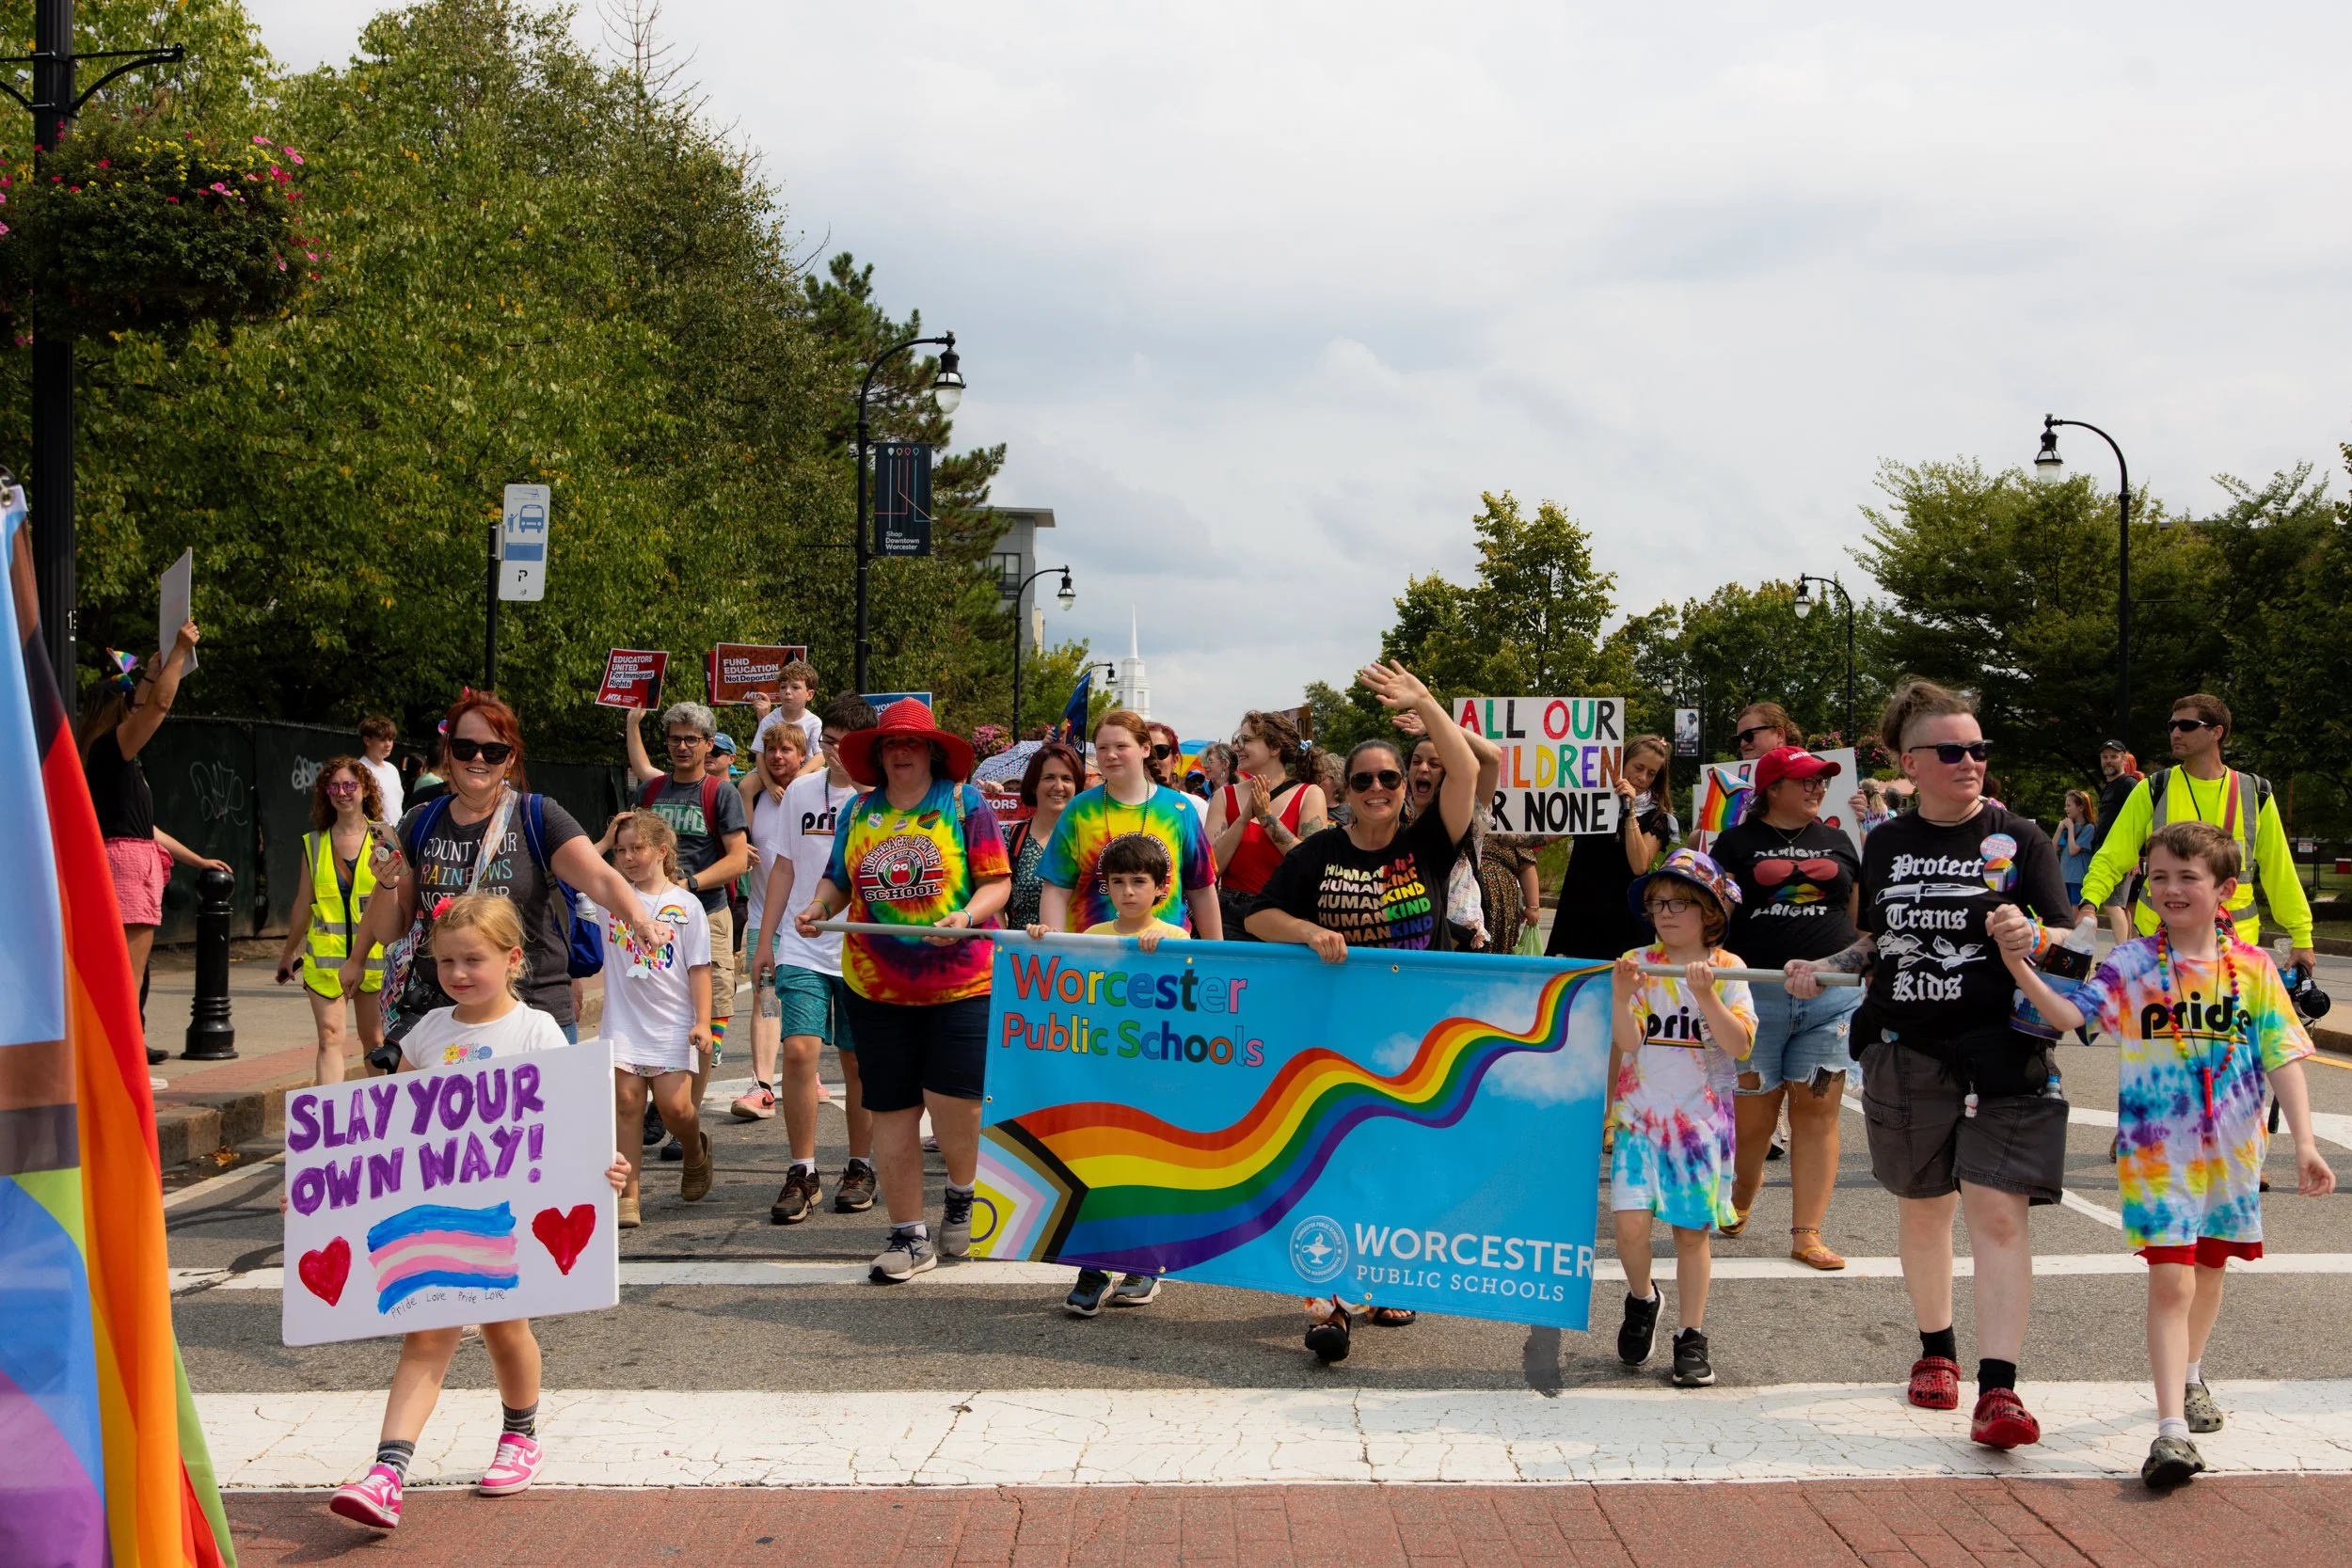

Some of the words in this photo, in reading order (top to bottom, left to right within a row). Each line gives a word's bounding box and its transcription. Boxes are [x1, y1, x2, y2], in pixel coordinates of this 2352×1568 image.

[723, 664, 779, 674] EDUCATION
[740, 673, 779, 683] Deportati
[604, 693, 622, 702] MTA
[1460, 700, 1526, 740] ALL
[1543, 700, 1619, 740] OUR
[1500, 744, 1622, 789] ILDREN
[802, 806, 837, 835] pri
[1491, 791, 1514, 832] R
[1524, 792, 1612, 832] NONE
[424, 837, 472, 863] COUNT
[861, 835, 911, 874] NORRBACK
[909, 834, 942, 866] AVENUE
[1888, 854, 1984, 882] Protect
[866, 884, 942, 902] SCHOOL
[1343, 915, 1434, 942] MANKIND
[1885, 903, 1969, 930] Trans
[1009, 953, 1248, 1014] Worcester
[1892, 971, 1963, 1002] Kids
[1644, 1006, 1702, 1046] pri
[2141, 991, 2252, 1039] pride
[1001, 1011, 1108, 1055] Public
[1117, 1020, 1264, 1068] Schools
[287, 1083, 398, 1153] SLAY
[407, 1063, 545, 1134] YOUR
[291, 1147, 404, 1216] OWN
[418, 1123, 544, 1191] WAY!
[1355, 1223, 1595, 1279] WORCESTER
[1356, 1264, 1441, 1289] PUBLIC
[1450, 1274, 1565, 1303] SCHOOLS
[390, 1297, 418, 1319] Pride
[458, 1291, 477, 1304] Pride
